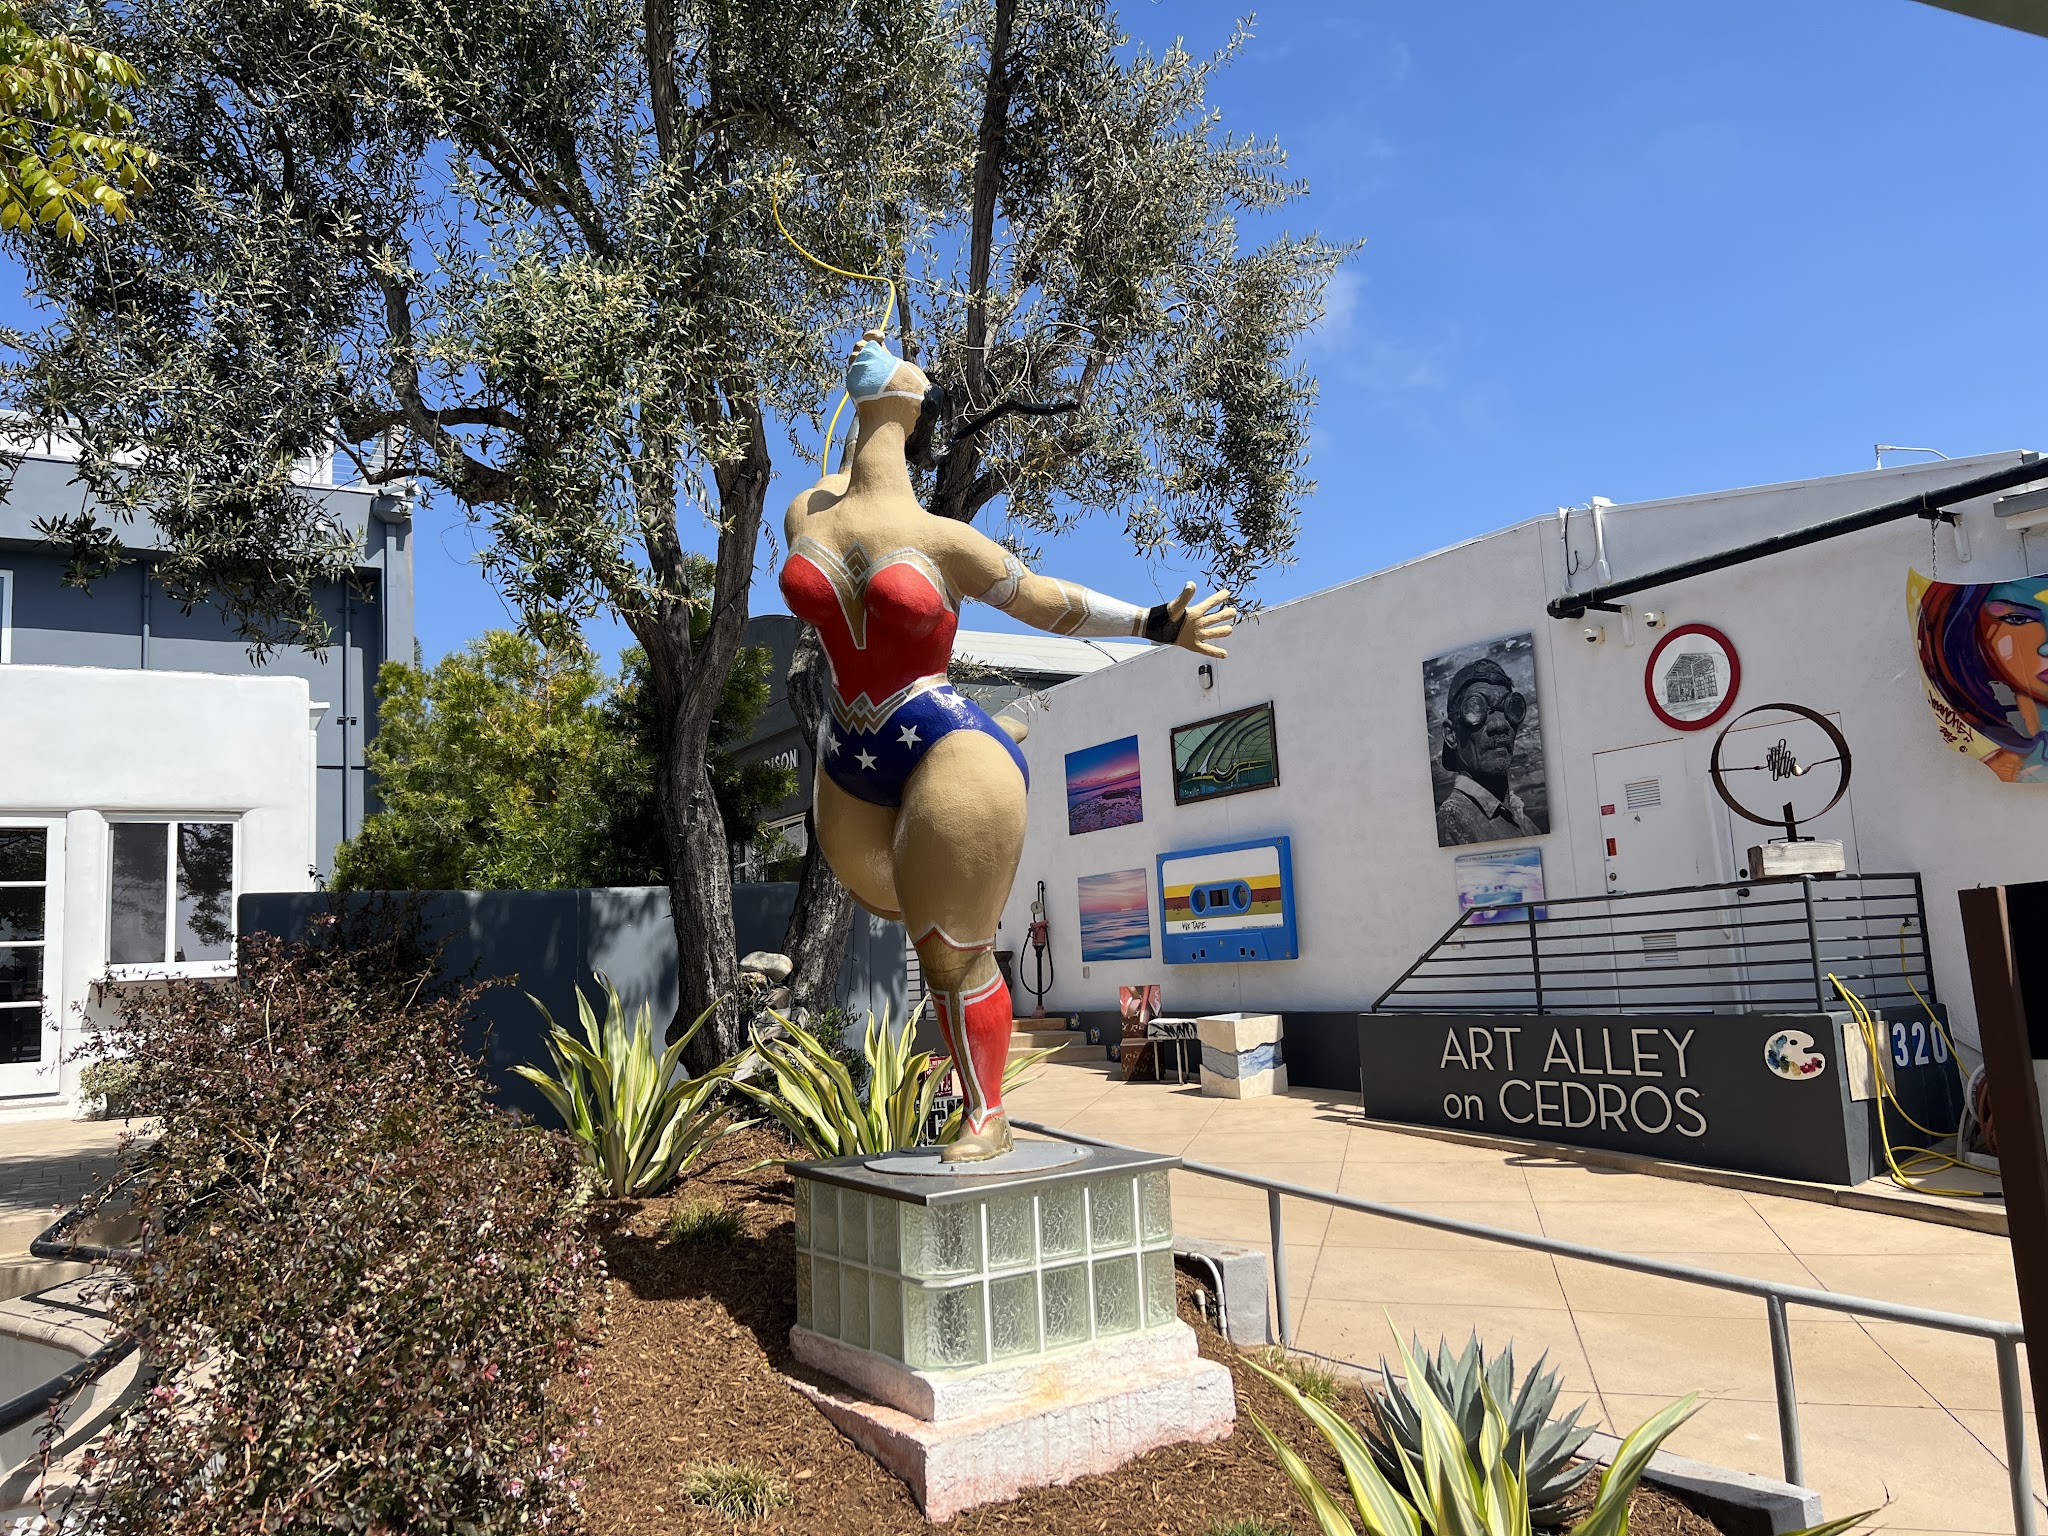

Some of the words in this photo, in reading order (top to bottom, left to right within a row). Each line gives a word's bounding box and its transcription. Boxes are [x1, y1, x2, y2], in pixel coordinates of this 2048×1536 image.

[1440, 1027, 1522, 1071] ART
[1543, 1027, 1695, 1079] ALLEY
[1892, 1020, 1948, 1066] 320
[1443, 1093, 1485, 1122] on
[1499, 1079, 1708, 1138] CEDROS
